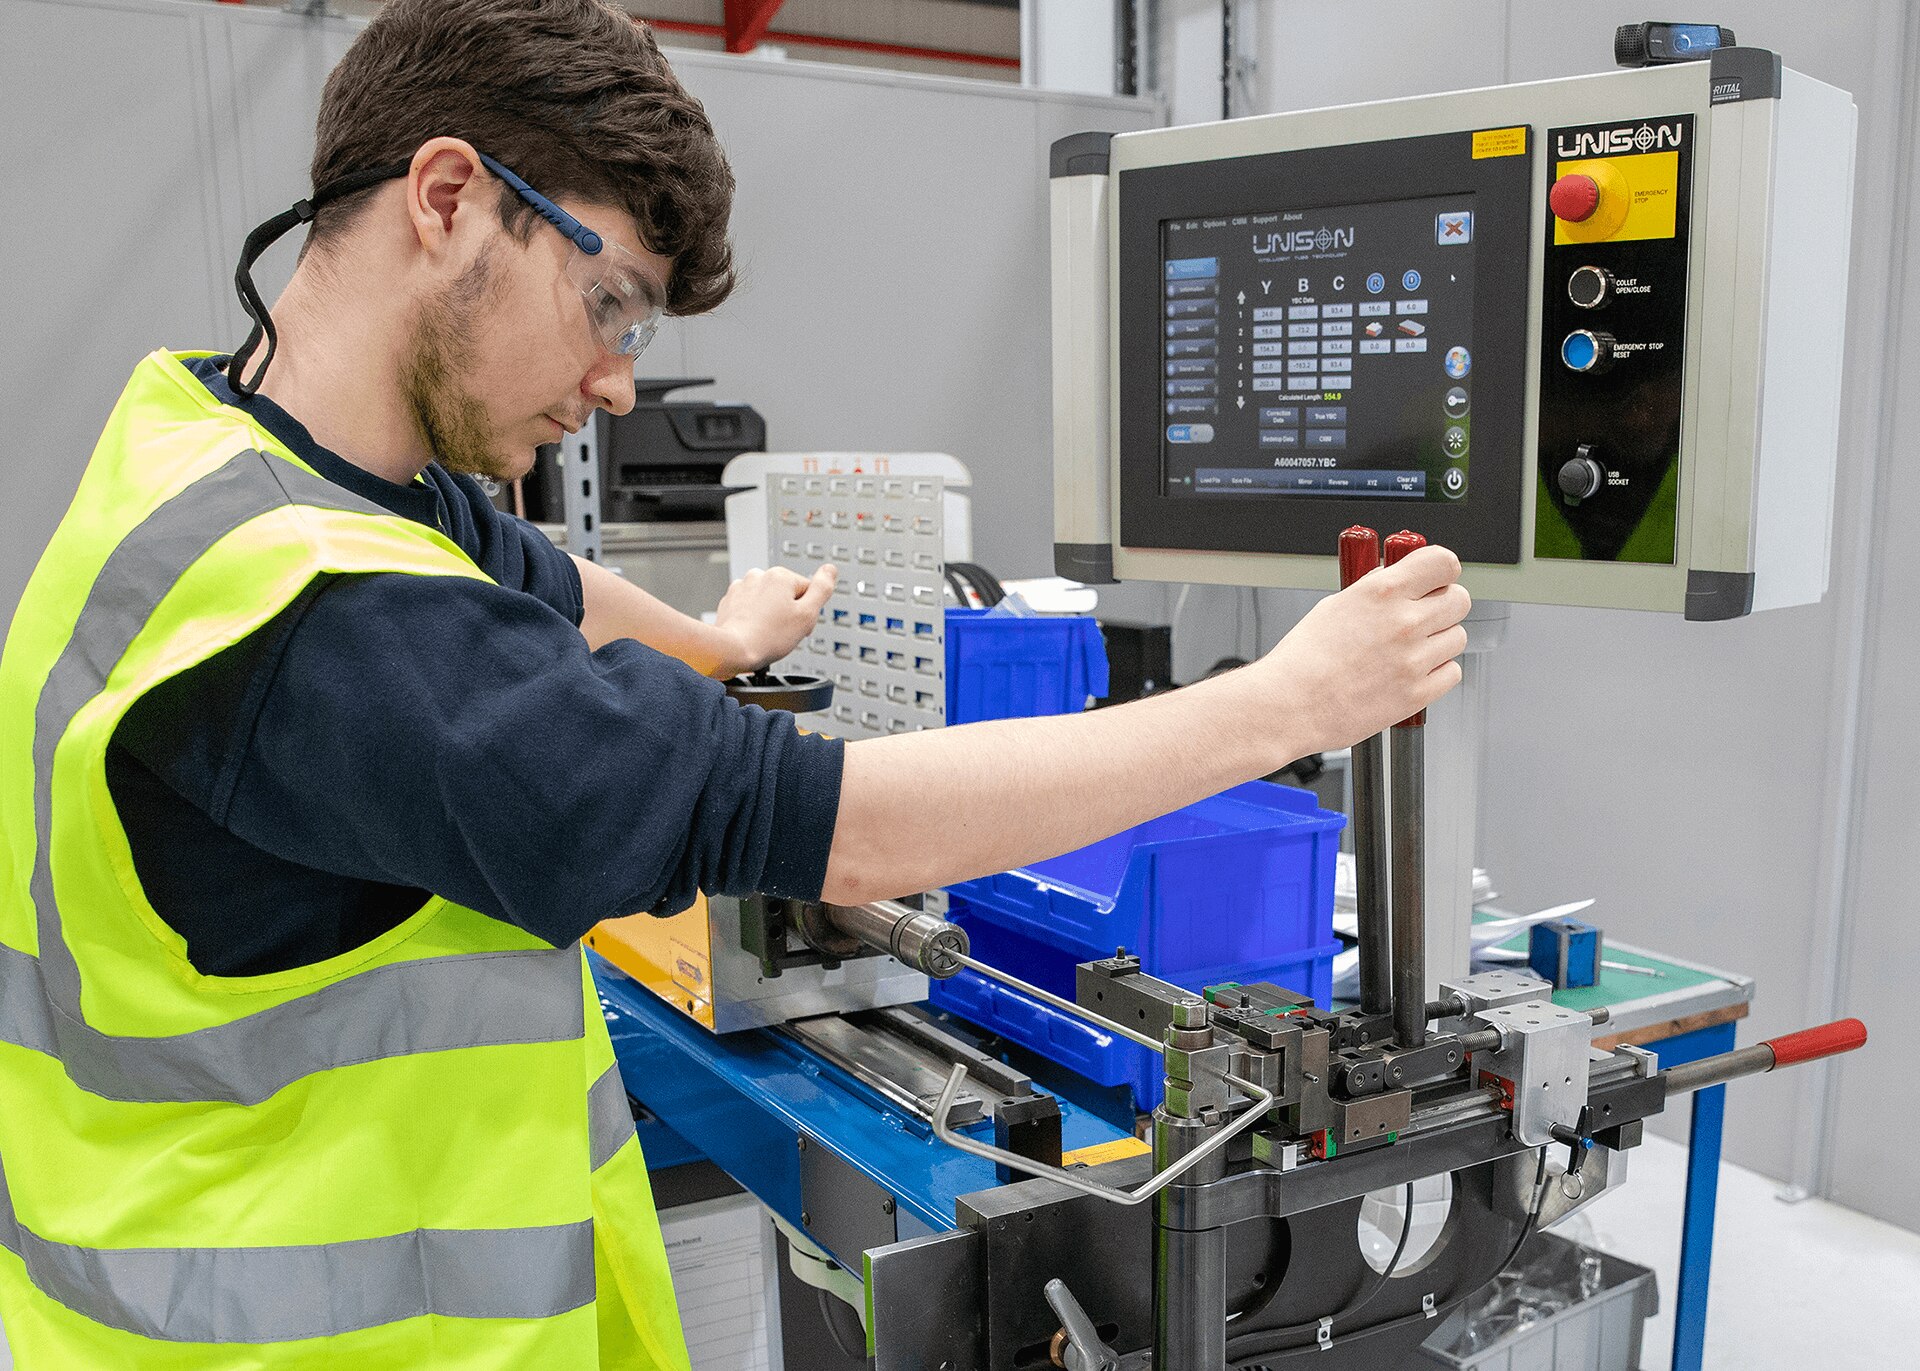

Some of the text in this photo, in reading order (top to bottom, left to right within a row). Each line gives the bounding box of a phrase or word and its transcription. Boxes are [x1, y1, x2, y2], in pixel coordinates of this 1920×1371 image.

[1712, 83, 1741, 95] RITTAL
[1558, 123, 1682, 158] UNISON
[1634, 189, 1668, 197] EMERGENCY
[1202, 220, 1226, 230] Options
[1252, 215, 1278, 225] Support
[1283, 213, 1303, 221] About
[1252, 226, 1354, 255] UNISON
[1261, 280, 1272, 295] Y
[1298, 278, 1309, 293] B
[1333, 275, 1345, 291] C
[1616, 278, 1637, 287] COLLET
[1615, 285, 1652, 294] OPEN/CLOSE
[1613, 342, 1664, 351] EMERGENCY STOP
[1323, 392, 1342, 400] 554.9
[1274, 457, 1337, 467] A60047057.YBC
[1328, 478, 1349, 486] Reverse
[1607, 478, 1630, 486] SOCKET
